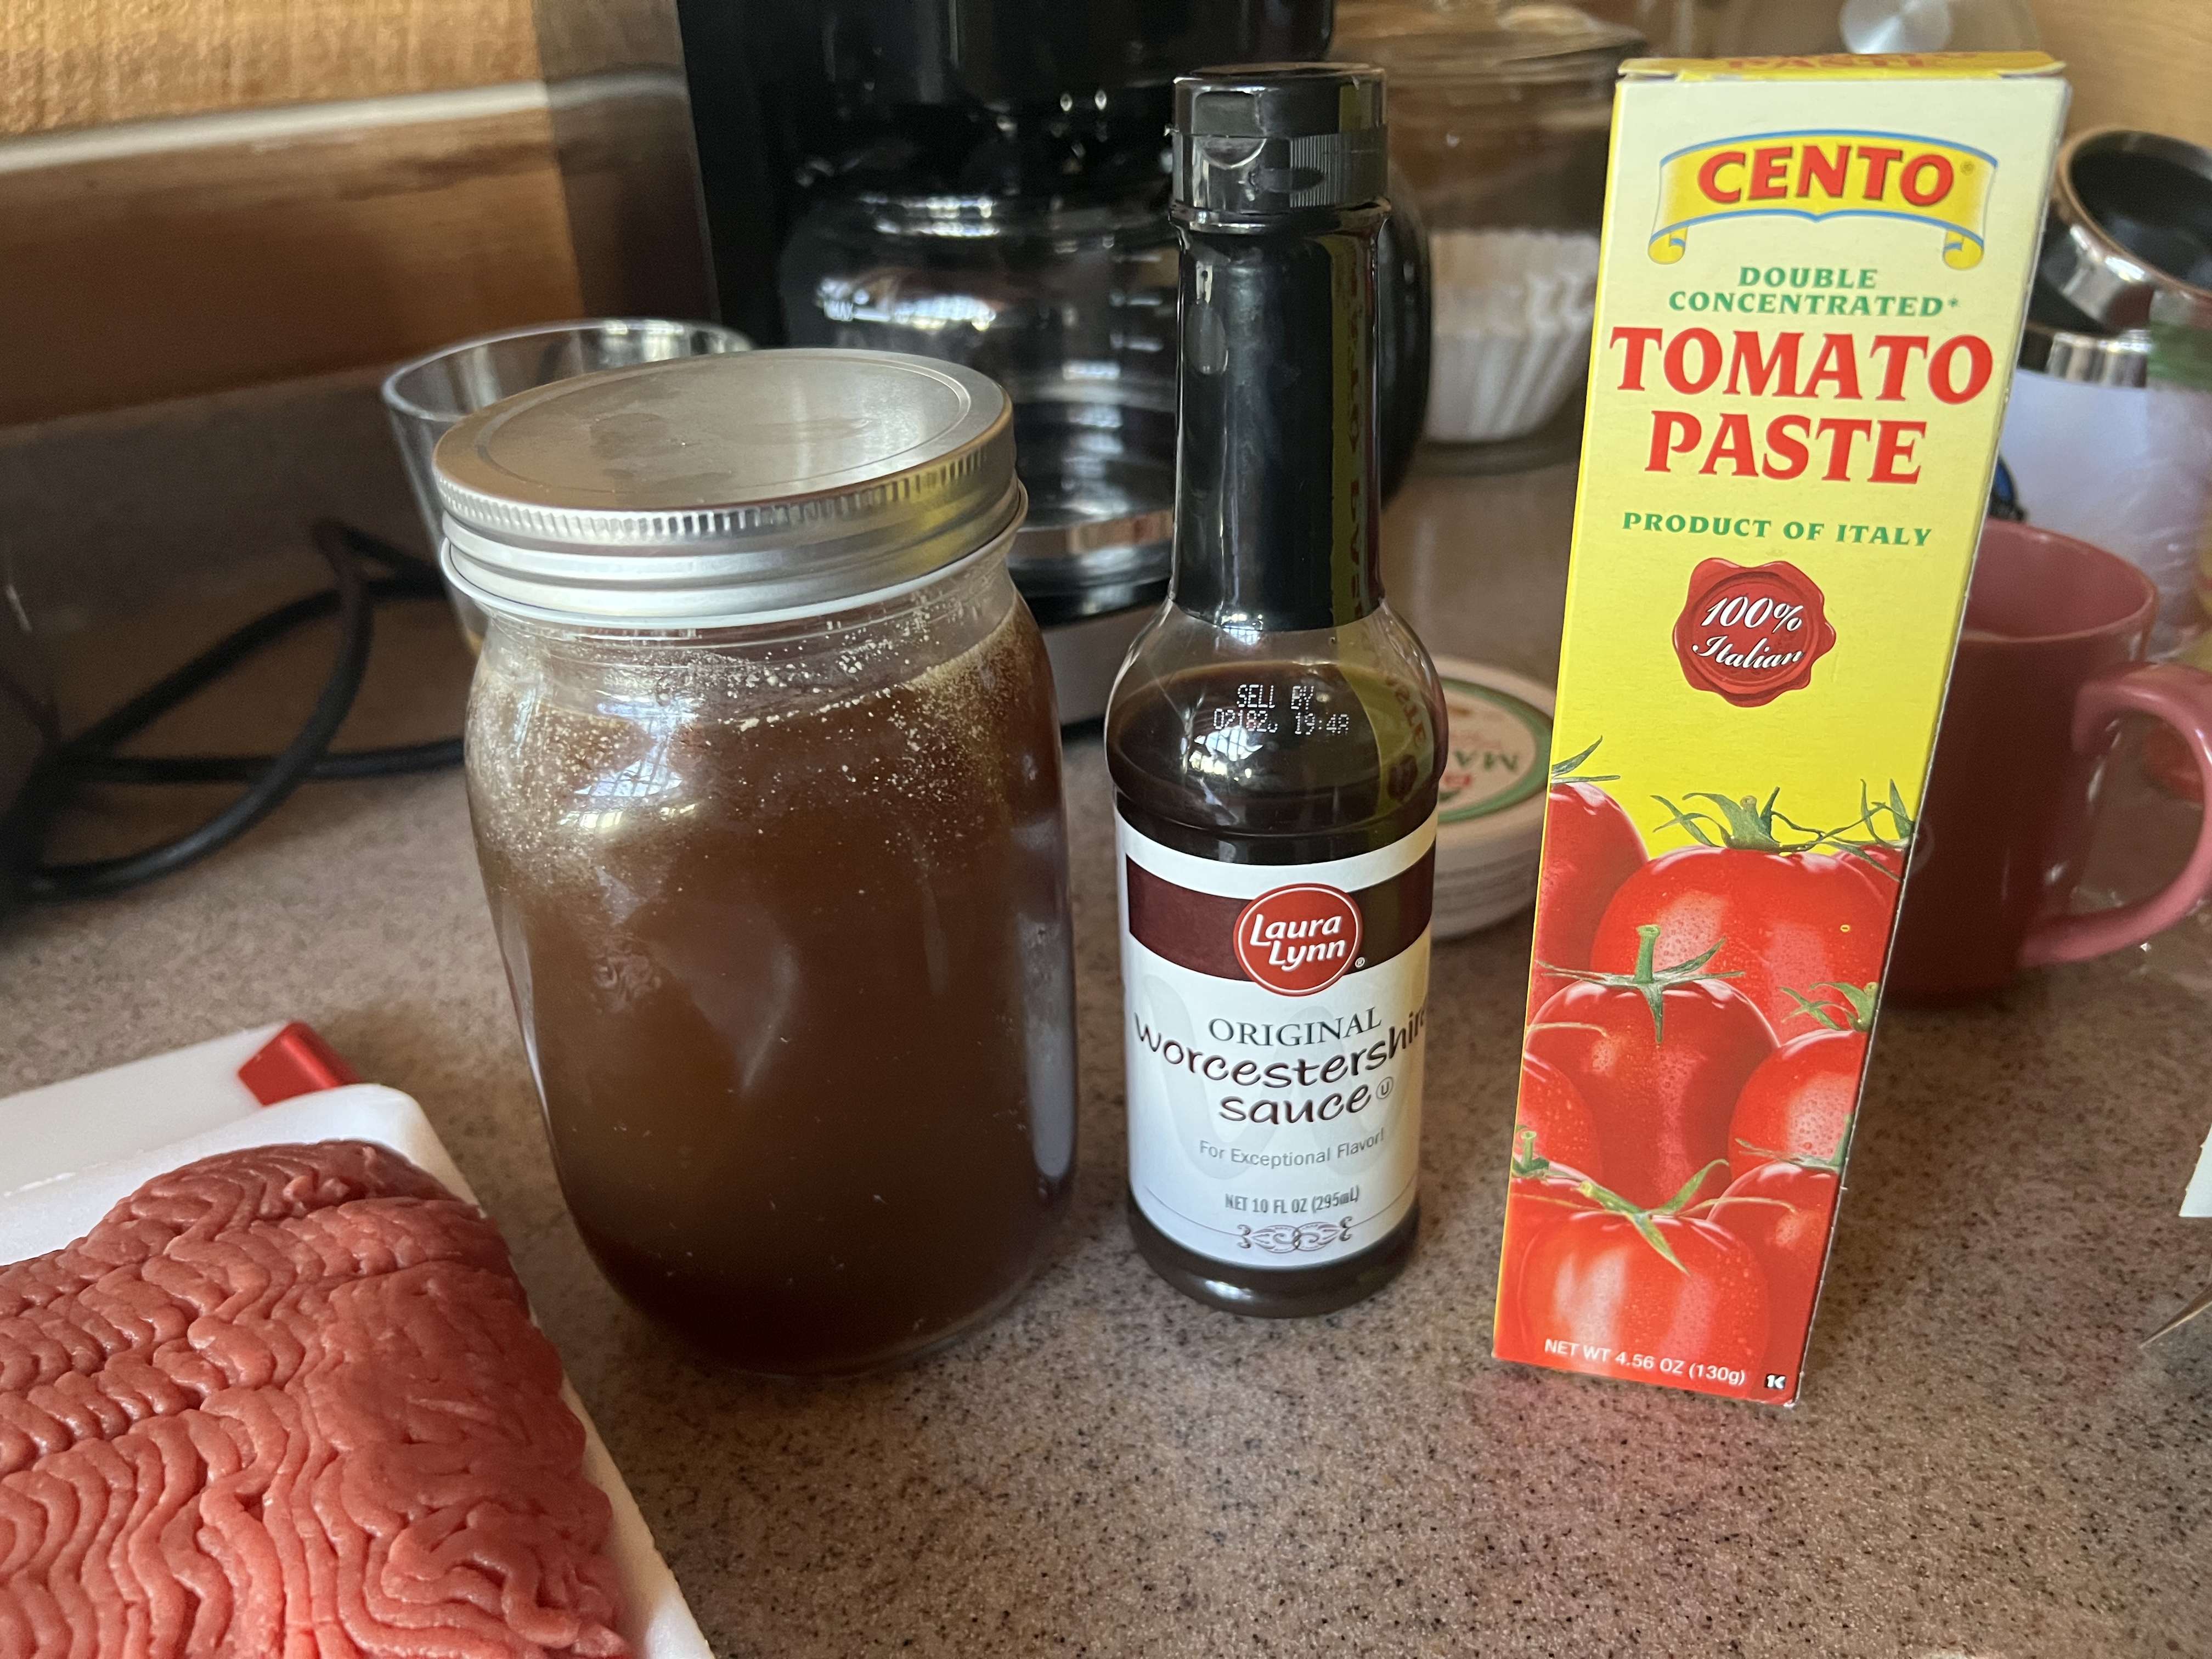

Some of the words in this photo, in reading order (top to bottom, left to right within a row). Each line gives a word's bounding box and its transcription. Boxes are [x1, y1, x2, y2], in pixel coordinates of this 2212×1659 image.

[1697, 145, 1955, 207] CENTO
[1737, 266, 1878, 290] DOUBLE
[1609, 326, 1994, 405] TOMATO
[1644, 410, 1927, 484] PASTE
[1621, 511, 1772, 538] PRODUCT
[1782, 521, 1825, 541] OF
[1836, 523, 1933, 547] ITALY
[1700, 595, 1804, 634] 100%
[1691, 635, 1804, 670] Italian
[1237, 684, 1276, 709] SELL
[1290, 685, 1314, 710] BY
[1250, 913, 1342, 947] Laura
[1268, 938, 1346, 972] Lynn
[1208, 1007, 1383, 1046] ORIGINAL
[1218, 1083, 1372, 1125] sauce
[1199, 1139, 1225, 1159] For
[1231, 1147, 1331, 1170] Exceptional
[1336, 1127, 1385, 1159] Flavor!
[1224, 1193, 1248, 1211] NET
[1252, 1198, 1269, 1214] 10
[1273, 1199, 1288, 1214] FL
[1291, 1198, 1308, 1214] OZ
[1544, 1338, 1581, 1358] NET
[1583, 1345, 1612, 1363] WT
[1615, 1351, 1655, 1370] 4.56
[1659, 1357, 1686, 1374] OZ
[1688, 1362, 1746, 1386] (130g)
